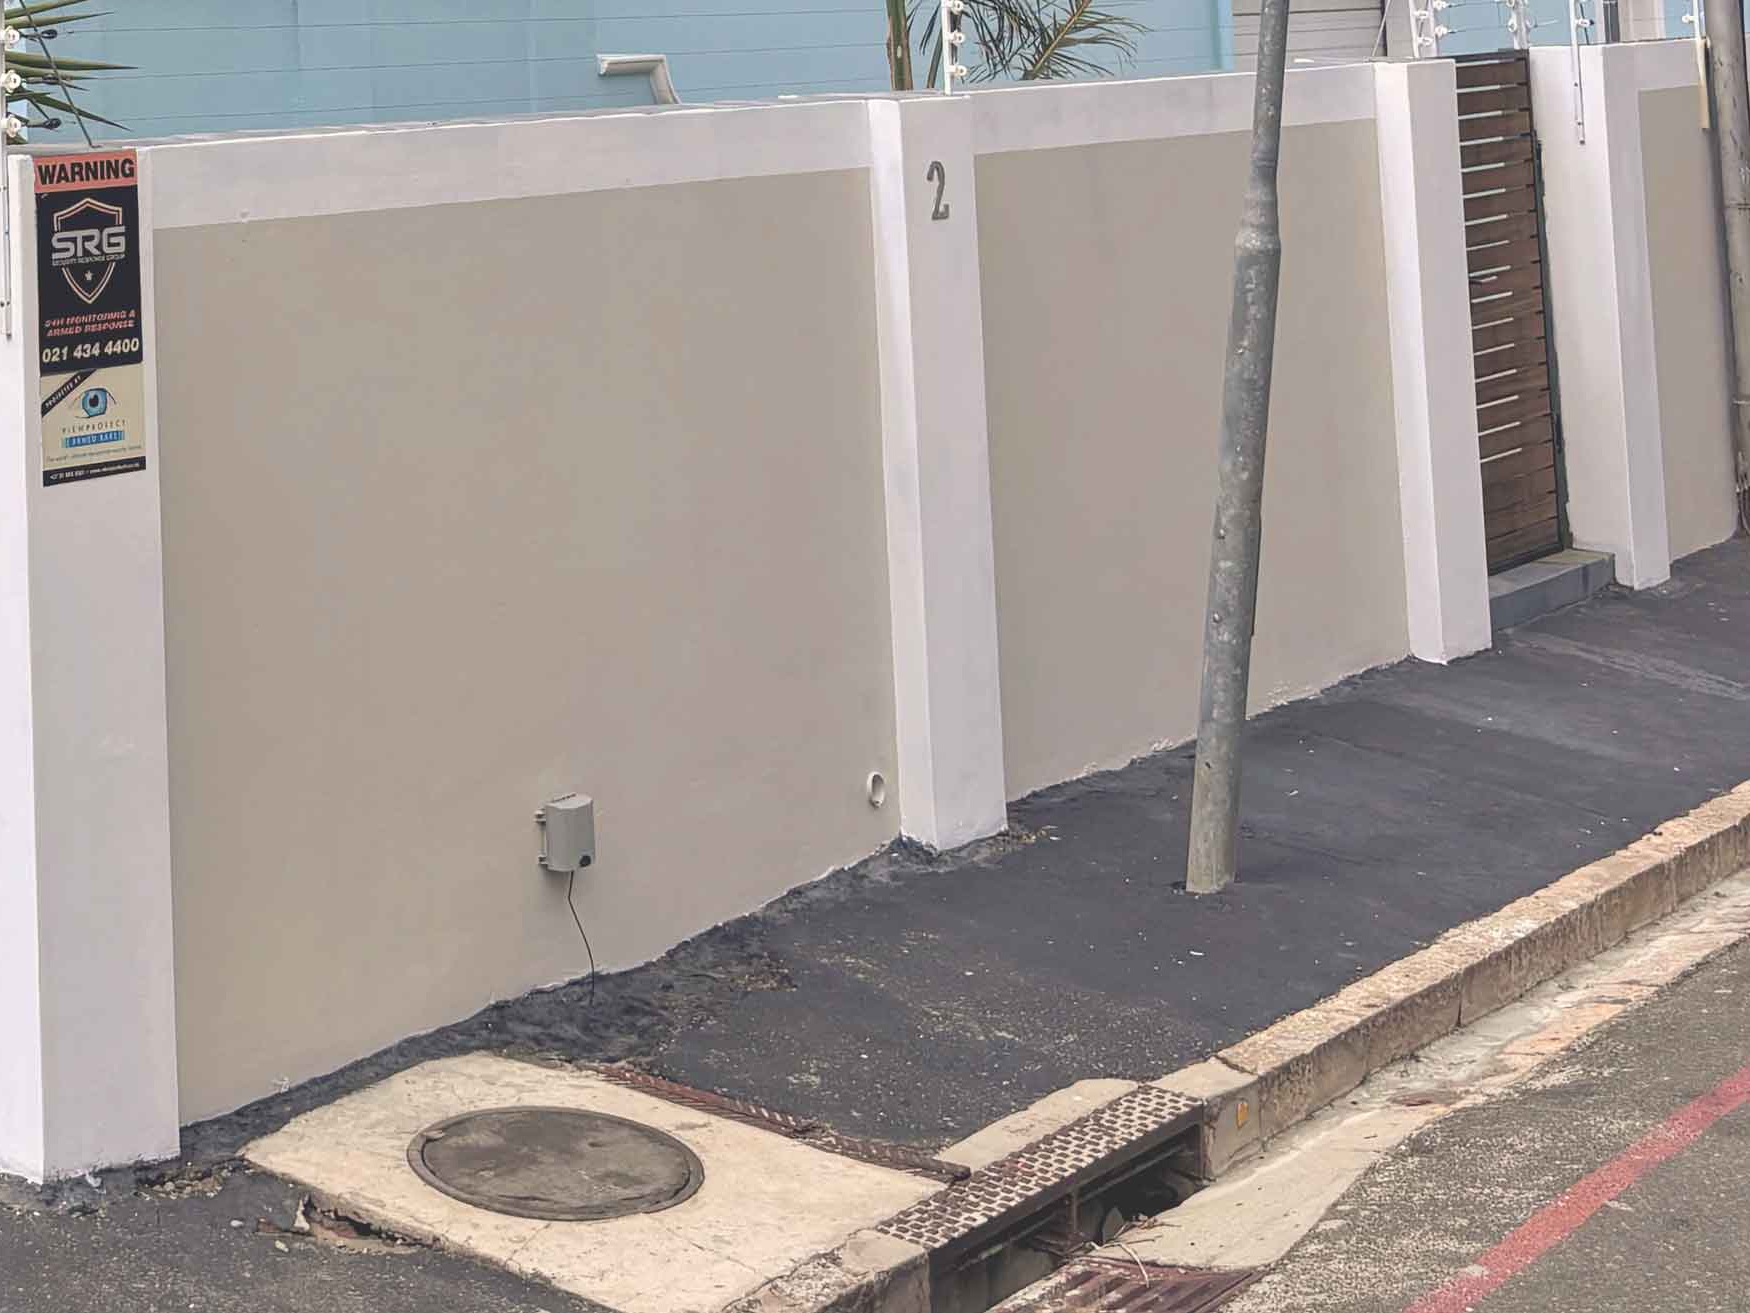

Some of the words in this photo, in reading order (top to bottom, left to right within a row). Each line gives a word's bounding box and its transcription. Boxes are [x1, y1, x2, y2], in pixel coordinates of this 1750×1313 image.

[37, 158, 134, 185] WARNING
[926, 160, 949, 221] 2
[51, 225, 125, 260] SRG
[42, 346, 68, 363] 021
[72, 342, 100, 359] 434
[104, 338, 139, 356] 4400
